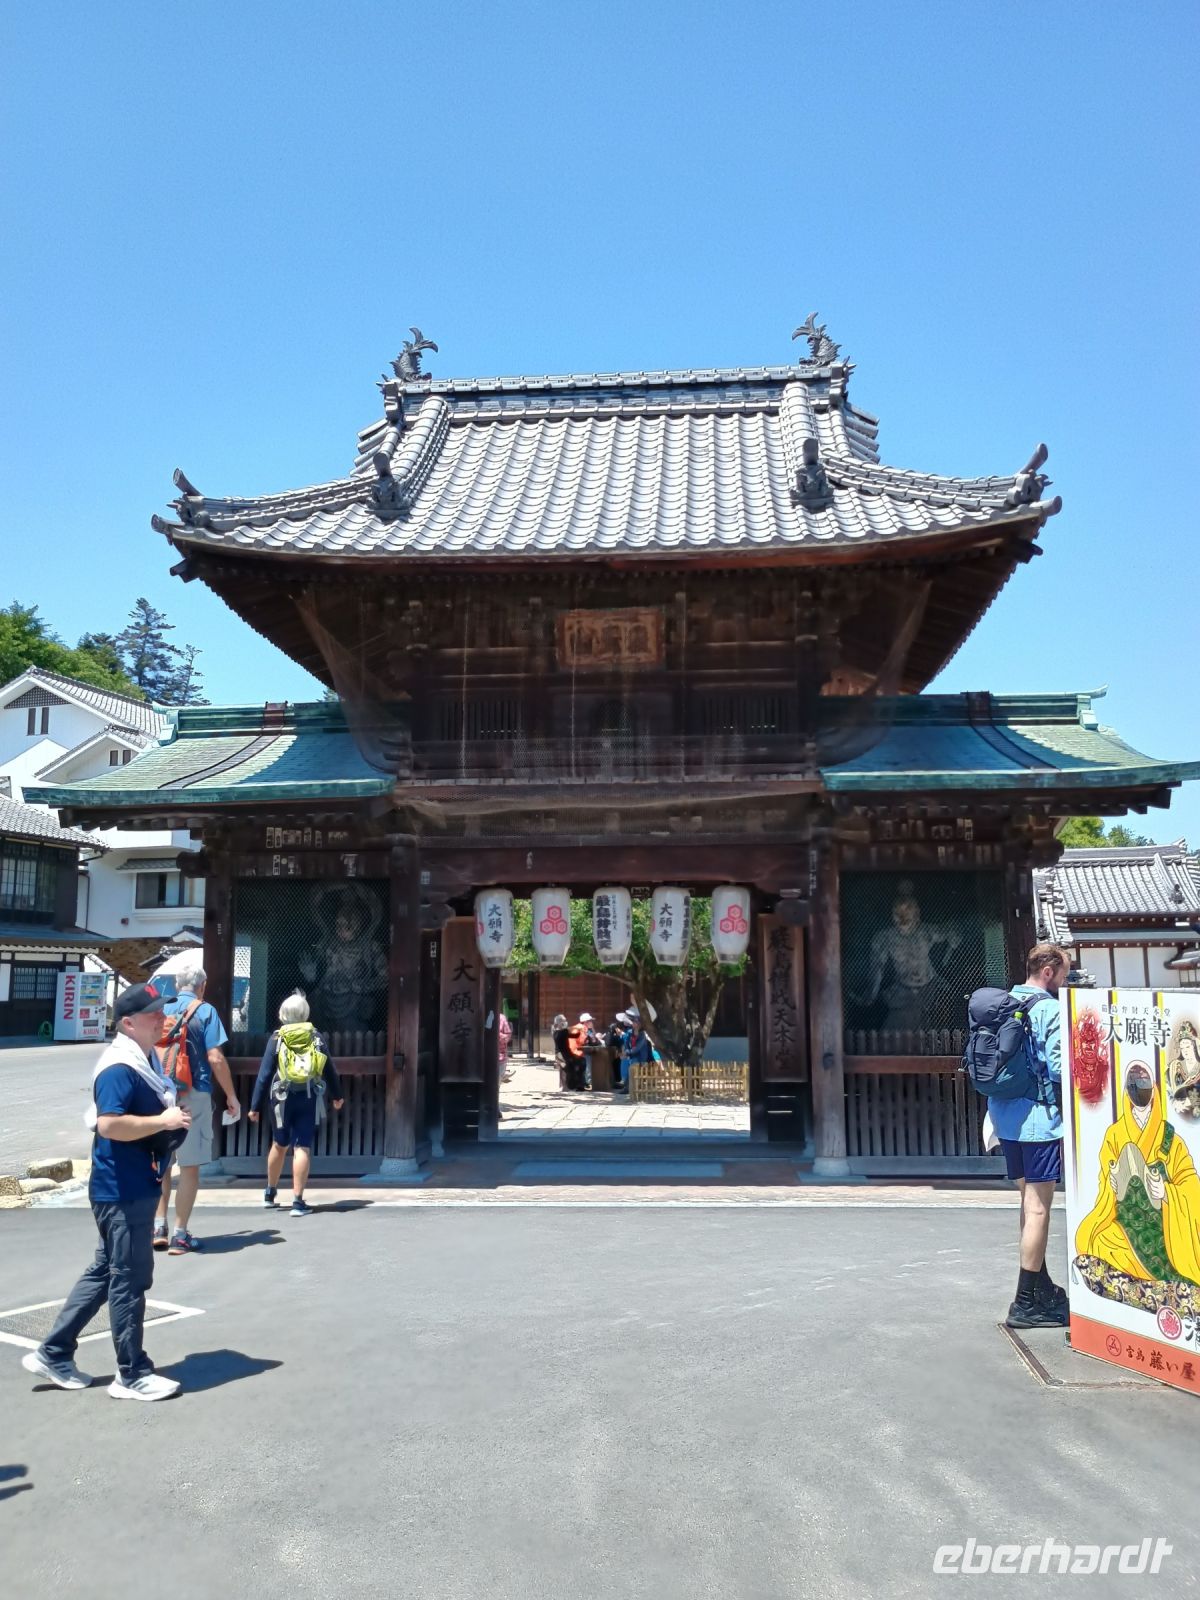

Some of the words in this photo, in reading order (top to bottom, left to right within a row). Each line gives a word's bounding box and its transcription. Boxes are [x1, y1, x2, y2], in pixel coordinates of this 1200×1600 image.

[487, 903, 504, 943] 大願寺
[658, 902, 673, 942] 大願寺
[63, 974, 76, 1020] KIRIN
[447, 957, 477, 1047] 大願寺
[1102, 1015, 1172, 1048] 大願寺
